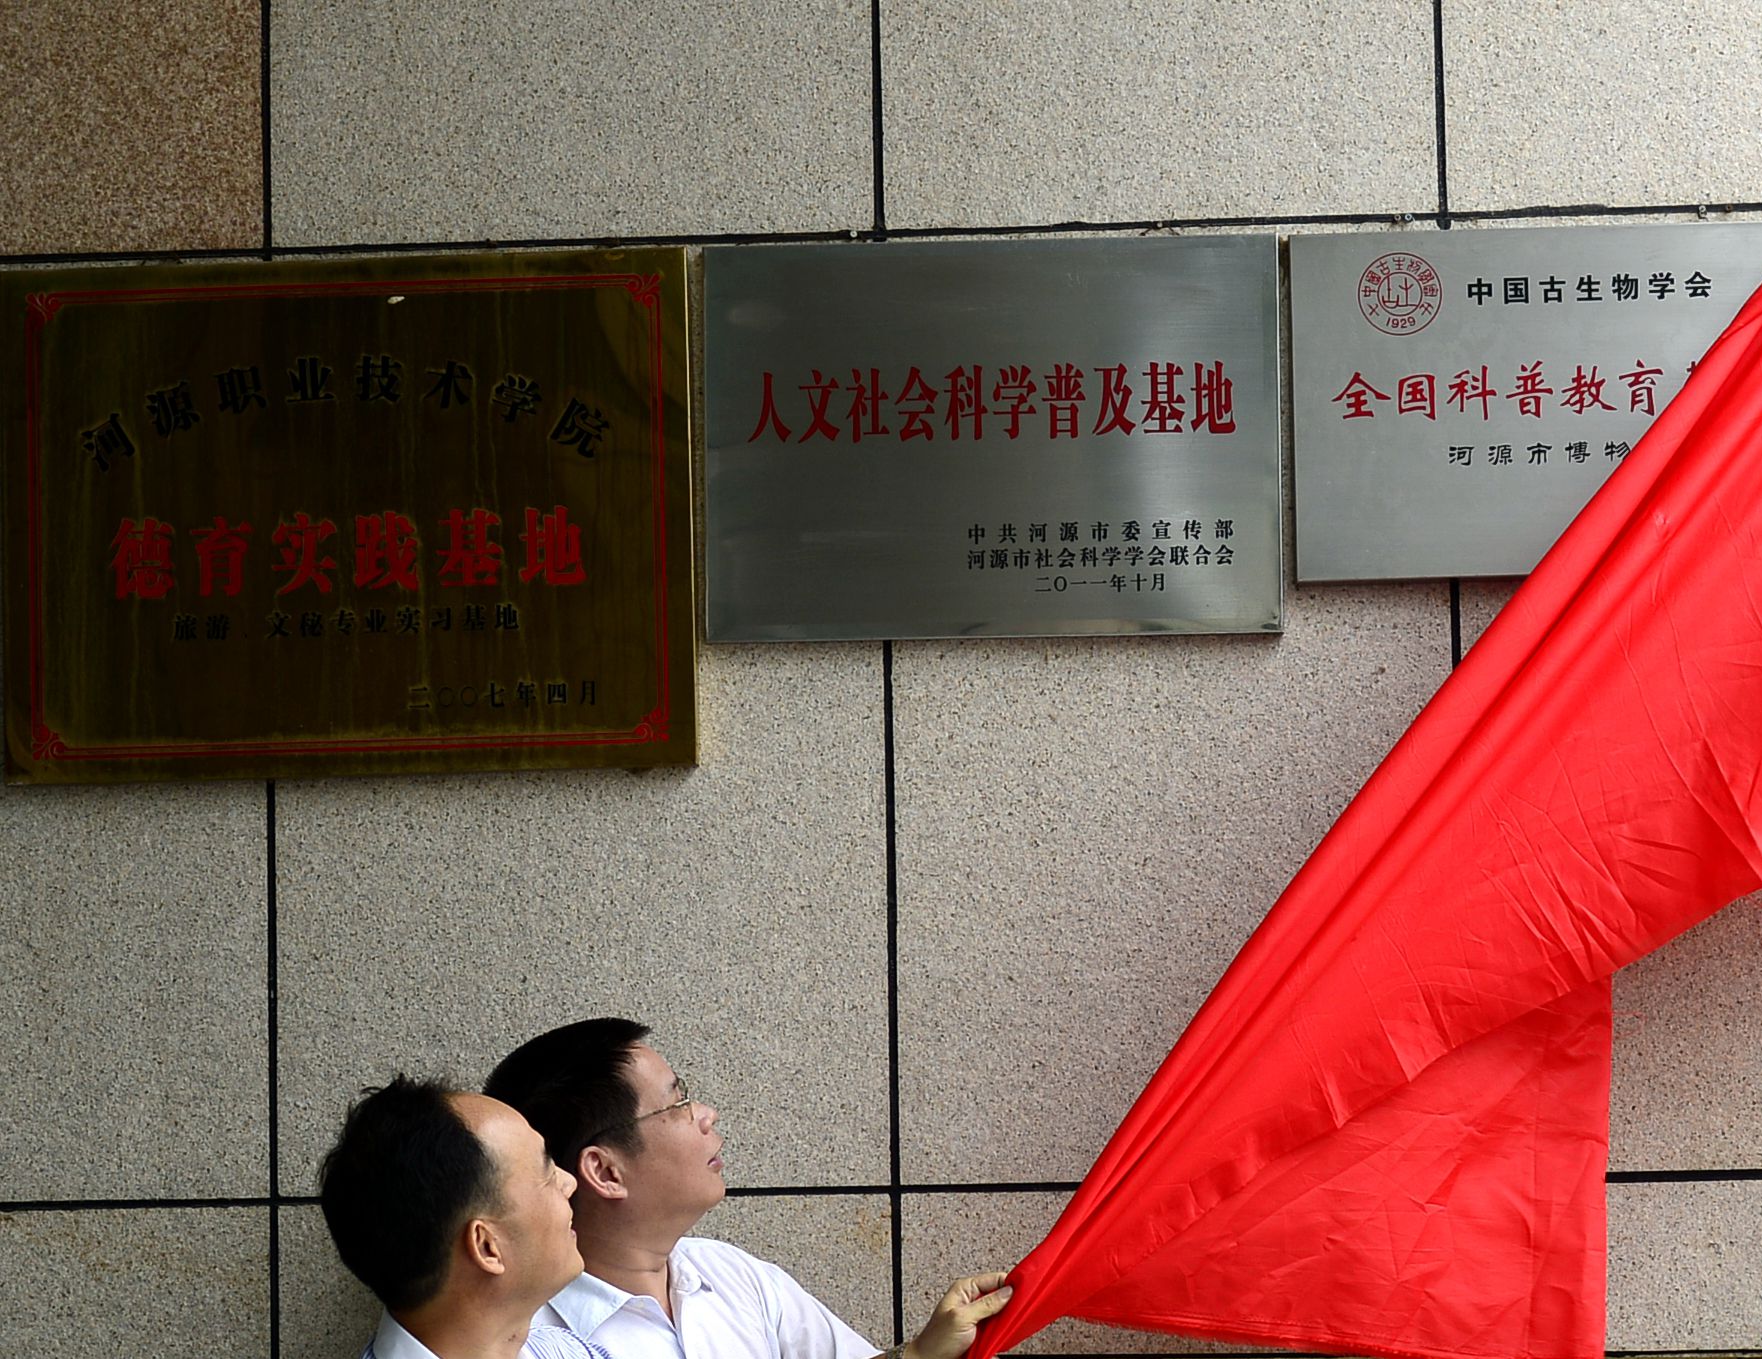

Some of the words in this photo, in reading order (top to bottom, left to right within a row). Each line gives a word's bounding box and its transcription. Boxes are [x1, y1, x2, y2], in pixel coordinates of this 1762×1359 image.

[1467, 272, 1712, 305] 中国古生物学会
[1386, 316, 1416, 329] 1929
[81, 354, 611, 470] 河源职业技术学院
[747, 360, 1236, 443] 人文社会科学普及基地
[1331, 359, 1698, 421] 全国科普教育
[109, 505, 588, 600] 德育实践基地
[967, 519, 1234, 543] 中共河源市委宣传部
[967, 545, 1234, 570] 河源市社会科学学会联合会
